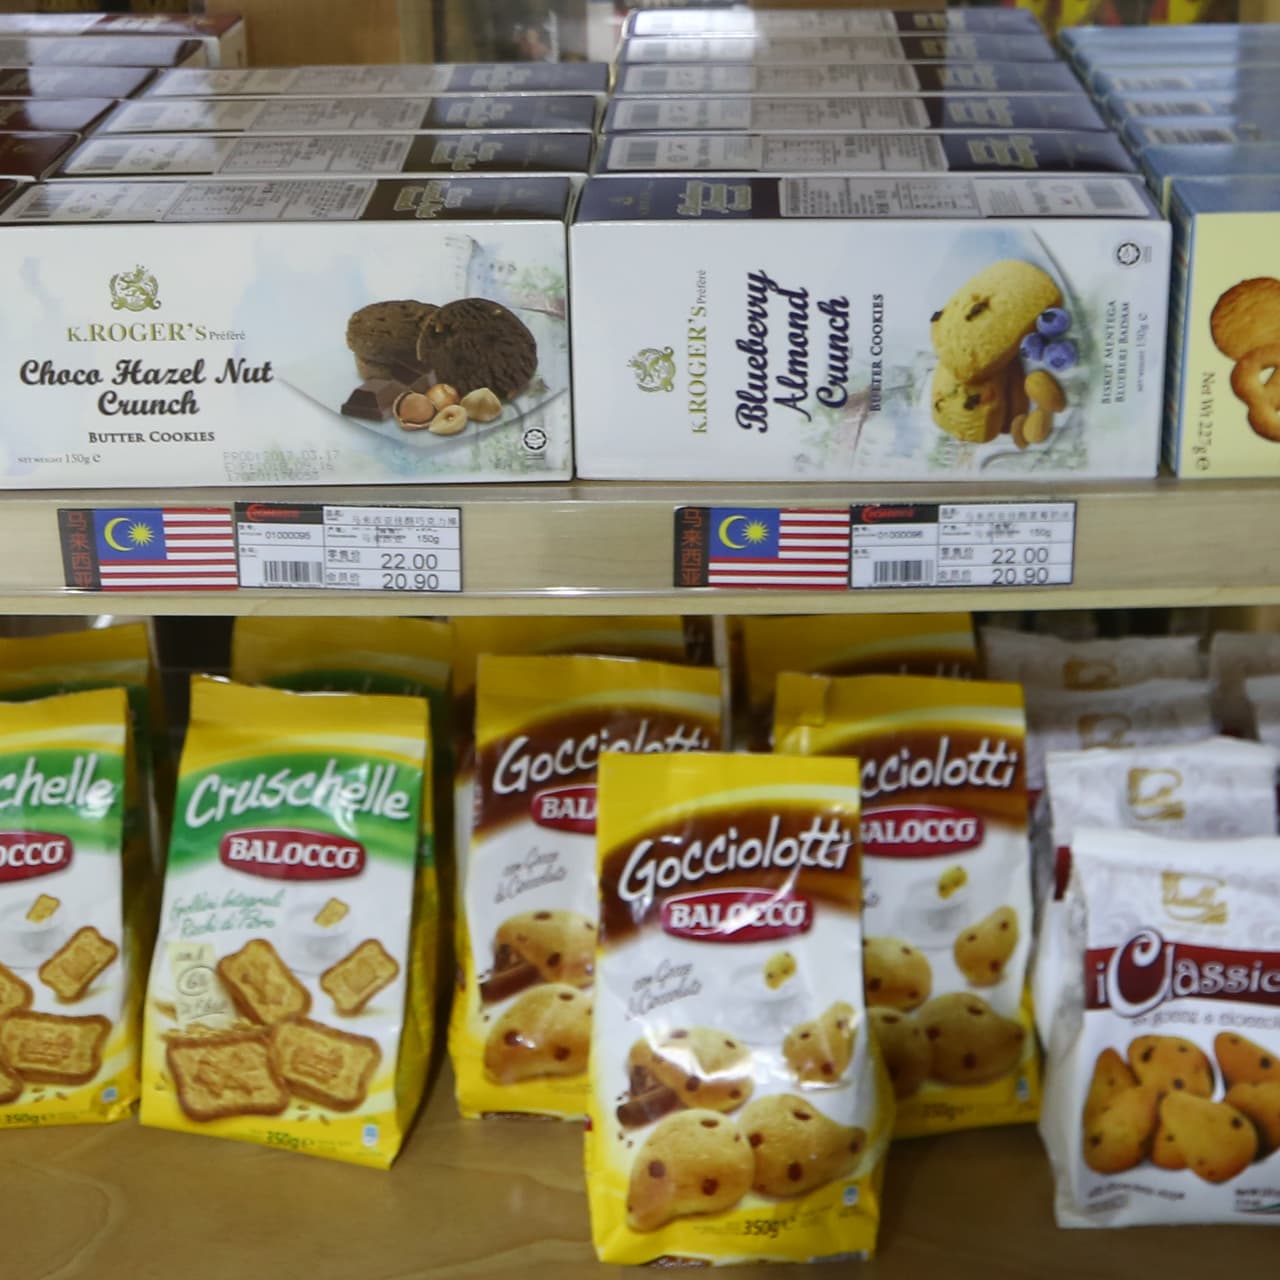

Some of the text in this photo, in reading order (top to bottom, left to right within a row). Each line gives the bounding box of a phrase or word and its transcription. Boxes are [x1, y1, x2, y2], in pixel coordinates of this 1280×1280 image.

[67, 322, 208, 342] K.ROGER'S
[735, 269, 779, 433] Blueberry
[773, 287, 811, 422] Almond
[816, 296, 850, 409] Crunch
[19, 358, 274, 386] Choco Hazel Nut
[688, 307, 707, 434] K.ROGER'S
[97, 390, 200, 417] Crunch
[381, 553, 438, 570] 22.00
[382, 574, 439, 590] 20.90
[185, 758, 411, 828] Cruschelle
[228, 838, 360, 870] BALOCCO
[618, 816, 851, 903] Gocciolotti
[669, 901, 806, 930] BALOCCO
